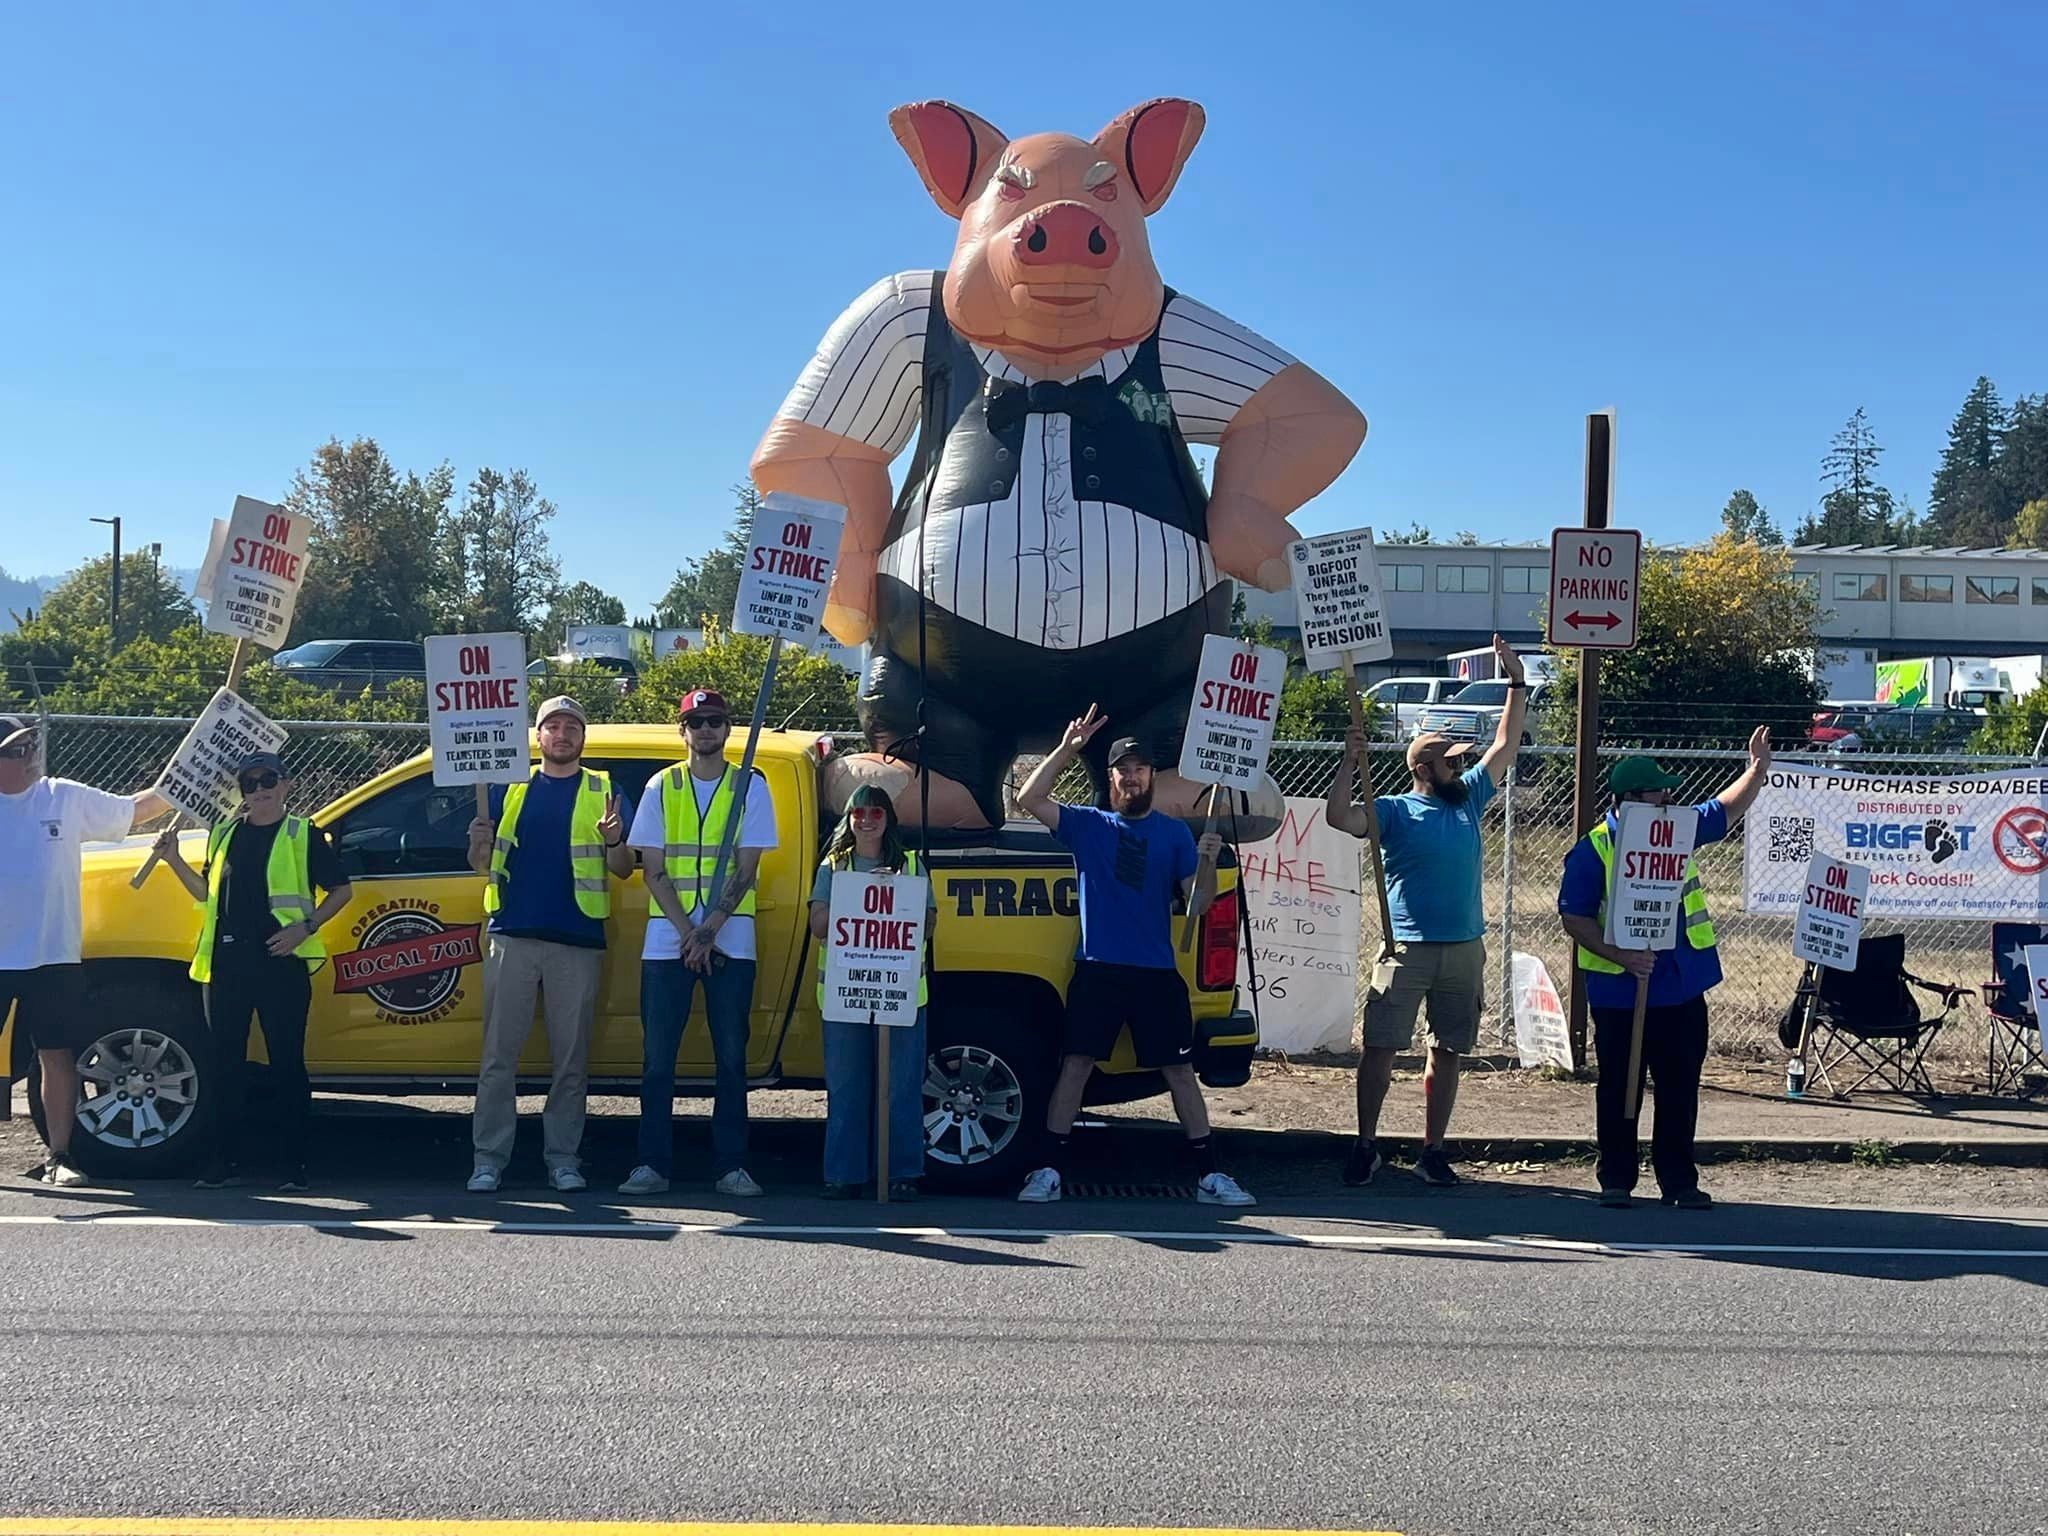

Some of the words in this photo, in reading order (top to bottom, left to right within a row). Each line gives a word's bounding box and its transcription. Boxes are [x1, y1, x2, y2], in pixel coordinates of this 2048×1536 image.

[263, 514, 291, 545] ON
[782, 523, 812, 549] ON
[1311, 537, 1344, 549] Teamsters
[1345, 533, 1368, 544] Locals
[1320, 549, 1336, 558] 206
[1346, 543, 1361, 552] 324
[231, 537, 300, 582] STRIKE
[751, 547, 830, 584] STRIKE
[1308, 557, 1358, 576] BIGFOOT
[1579, 546, 1612, 568] NO
[1313, 571, 1357, 589] UNFAIR
[1560, 578, 1628, 601] PARKING
[238, 586, 270, 602] UNFAIR
[272, 597, 281, 608] TO
[761, 590, 792, 605] UNFAIR
[797, 597, 808, 609] TO
[1305, 592, 1328, 602] They
[1332, 586, 1356, 598] Need
[1359, 584, 1369, 593] to
[226, 600, 267, 618] TEAMSTERS
[749, 603, 791, 619] TEAMSTERS
[794, 614, 814, 625] UNION
[1314, 604, 1338, 615] Keep
[1341, 598, 1365, 610] Their
[230, 613, 252, 625] LOCAL
[753, 615, 775, 626] LOCAL
[778, 619, 789, 628] NO.
[791, 622, 806, 632] 206
[1304, 619, 1330, 630] Paws
[1334, 616, 1347, 625] off
[1351, 613, 1360, 622] of
[1364, 610, 1380, 619] our
[1307, 622, 1383, 649] PENSION!
[459, 645, 490, 675] ON
[1230, 653, 1259, 683] ON
[435, 679, 519, 711] STRIKE
[1200, 681, 1275, 721] STRIKE
[214, 718, 262, 753] BIGFOOT
[455, 731, 488, 744] UNFAIR
[493, 730, 505, 742] TO
[1208, 731, 1236, 748] UNFAIR
[1242, 738, 1252, 751] TO
[193, 739, 215, 760] They
[446, 749, 491, 761] TEAMSTERS
[494, 748, 517, 758] UNION
[1196, 747, 1236, 764] TEAMSTERS
[1238, 757, 1258, 768] UNION
[190, 755, 213, 776] Keep
[215, 771, 234, 792] Their
[455, 762, 477, 772] LOCAL
[480, 761, 492, 771] NO.
[495, 760, 510, 770] 206
[1200, 760, 1221, 772] LOCAL
[1223, 764, 1233, 775] NO.
[1235, 767, 1249, 778] 206
[171, 760, 194, 782] Paws
[196, 780, 212, 792] off
[210, 788, 221, 798] of
[220, 798, 236, 810] our
[1827, 777, 1941, 794] PURCHASE
[1857, 802, 1942, 815] DISTRIBUTED
[1947, 804, 1963, 815] BY
[1650, 820, 1674, 848] ON
[1624, 852, 1688, 881] STRIKE
[1846, 852, 1921, 862] BEVERAGES
[1240, 852, 1335, 896] riKE
[1826, 866, 1848, 889] ON
[1906, 872, 1974, 888] Goods!!!
[864, 885, 894, 915] ON
[1634, 900, 1661, 912] UNFAIR
[1805, 884, 1861, 919] STRIKE
[1869, 896, 1891, 905] their
[1894, 898, 1921, 908] paws
[1925, 898, 1938, 907] off
[351, 898, 440, 938] OPERATING
[1293, 919, 1315, 935] TO
[1624, 916, 1661, 927] TEAMSTERS
[836, 918, 918, 951] STRIKE
[1630, 928, 1648, 938] LOCAL
[1810, 922, 1833, 936] UNFAIR
[1836, 929, 1845, 939] TO
[1801, 933, 1832, 948] TEAMSTERS
[1804, 943, 1820, 954] LOCAL
[342, 948, 425, 980] LOCAL
[429, 938, 474, 962] 701
[844, 952, 868, 960] Bigfoot
[870, 952, 905, 961] Beverages
[848, 969, 882, 983] UNFAIR
[886, 971, 898, 983] TO
[838, 986, 882, 999] TEAMSTERS
[885, 989, 907, 1000] UNION
[376, 988, 465, 1026] ENGINEERS
[844, 999, 867, 1009] LOCAL
[870, 1000, 881, 1011] NO.
[884, 1001, 898, 1011] 206
